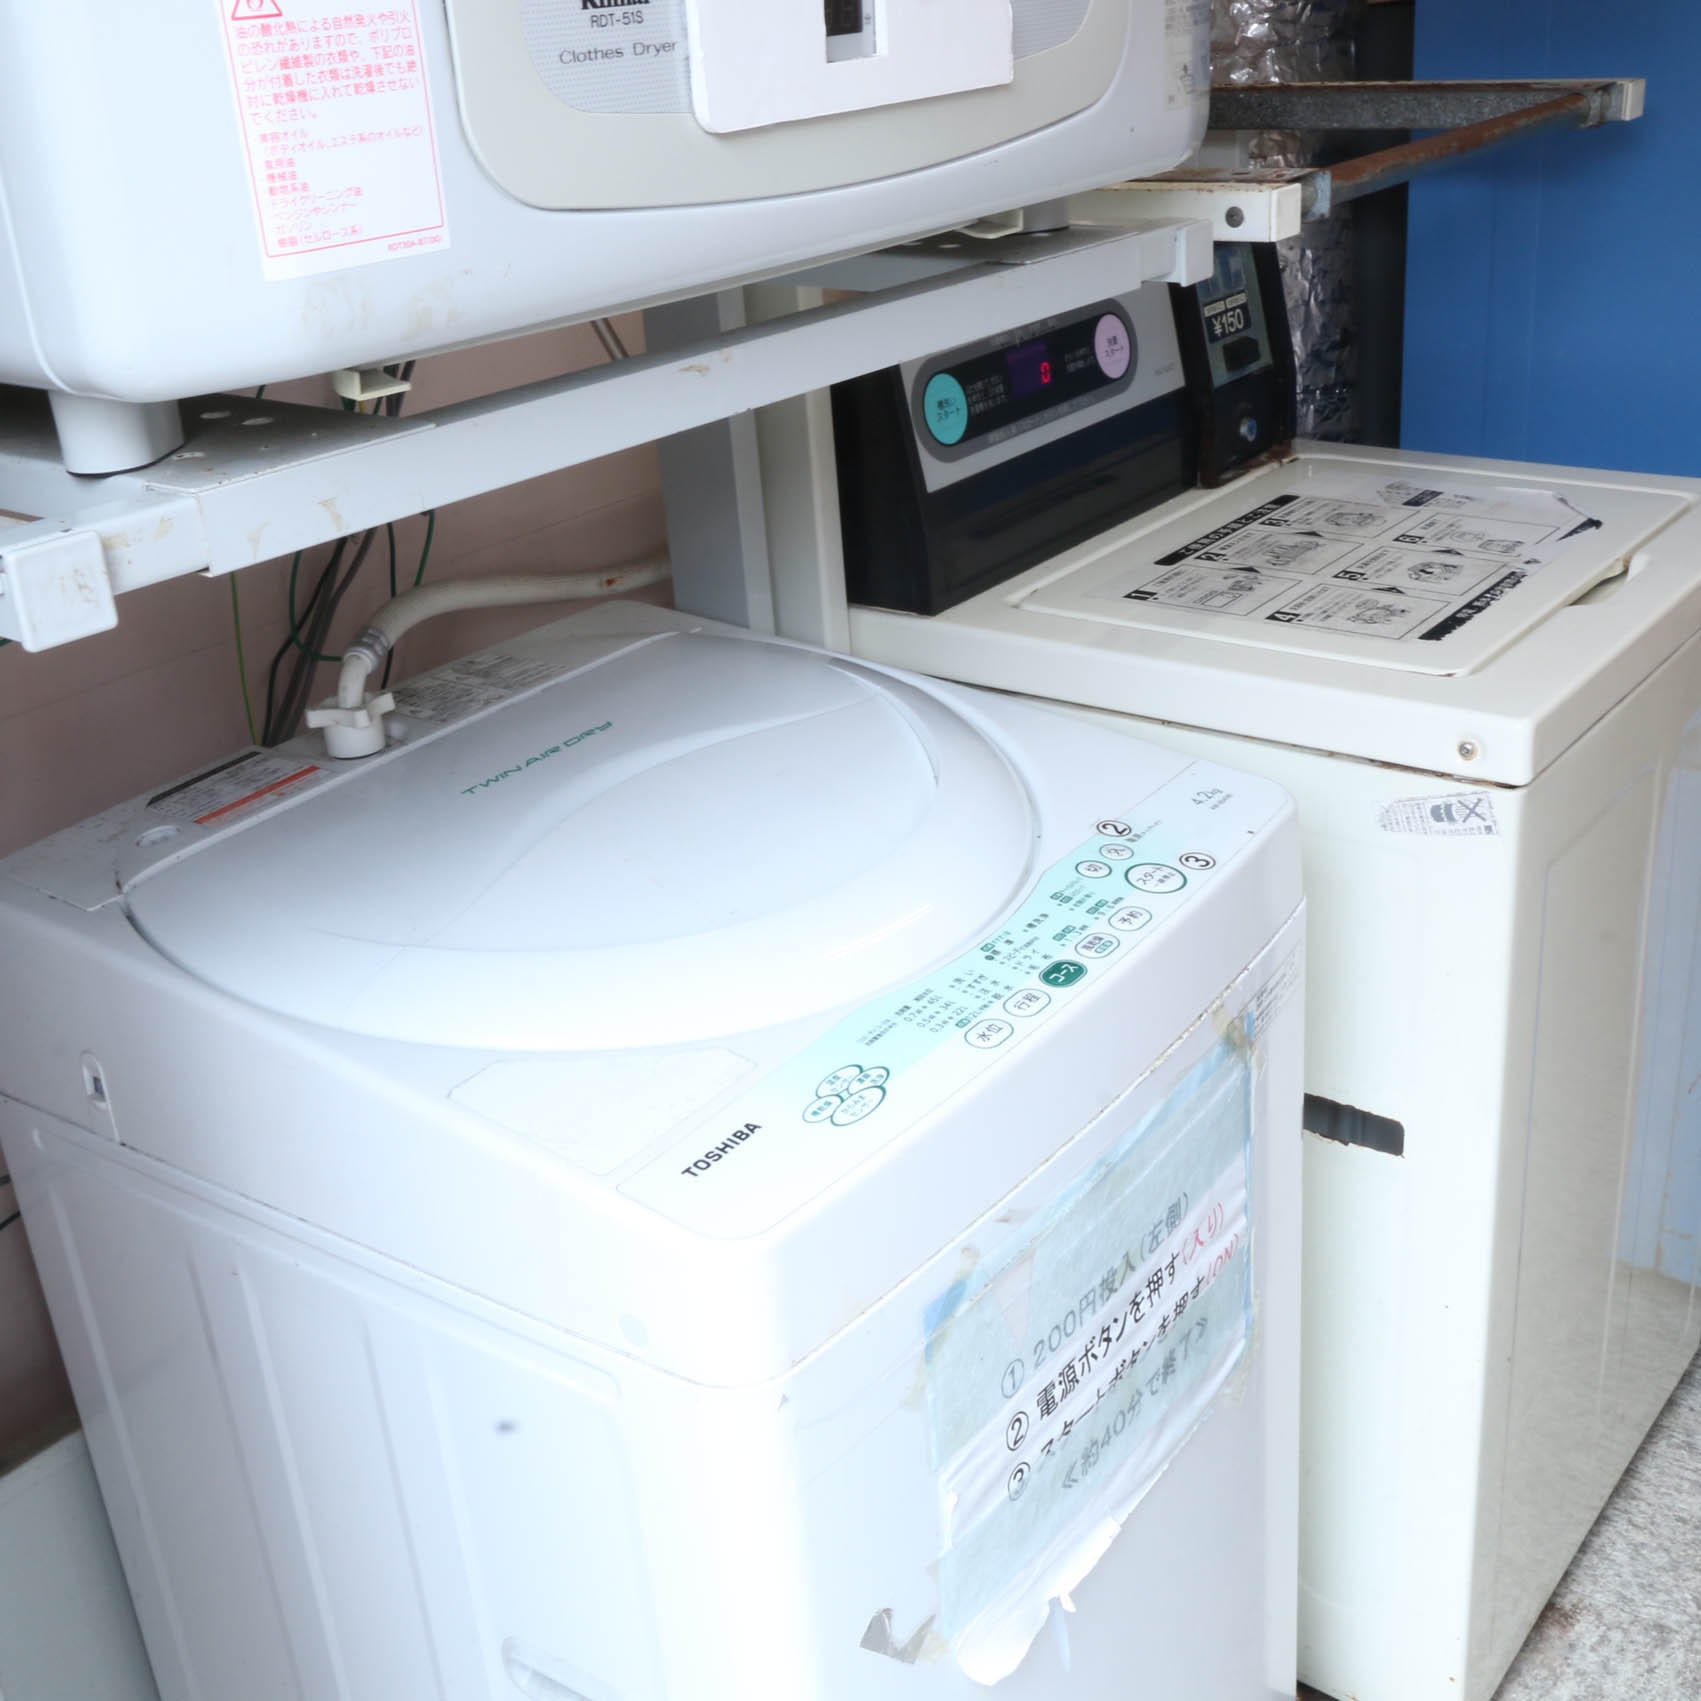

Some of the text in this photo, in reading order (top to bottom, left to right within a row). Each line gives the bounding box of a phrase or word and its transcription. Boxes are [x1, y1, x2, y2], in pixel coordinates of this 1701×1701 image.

[590, 10, 645, 28] RDT-51S
[560, 41, 678, 64] Clothes Dryer
[1212, 309, 1244, 337] ¥150
[461, 721, 612, 794] TWIN AIR DRY
[1049, 963, 1079, 983] コース
[977, 1024, 1003, 1042] 水位
[681, 1122, 762, 1177] TOSHIBA
